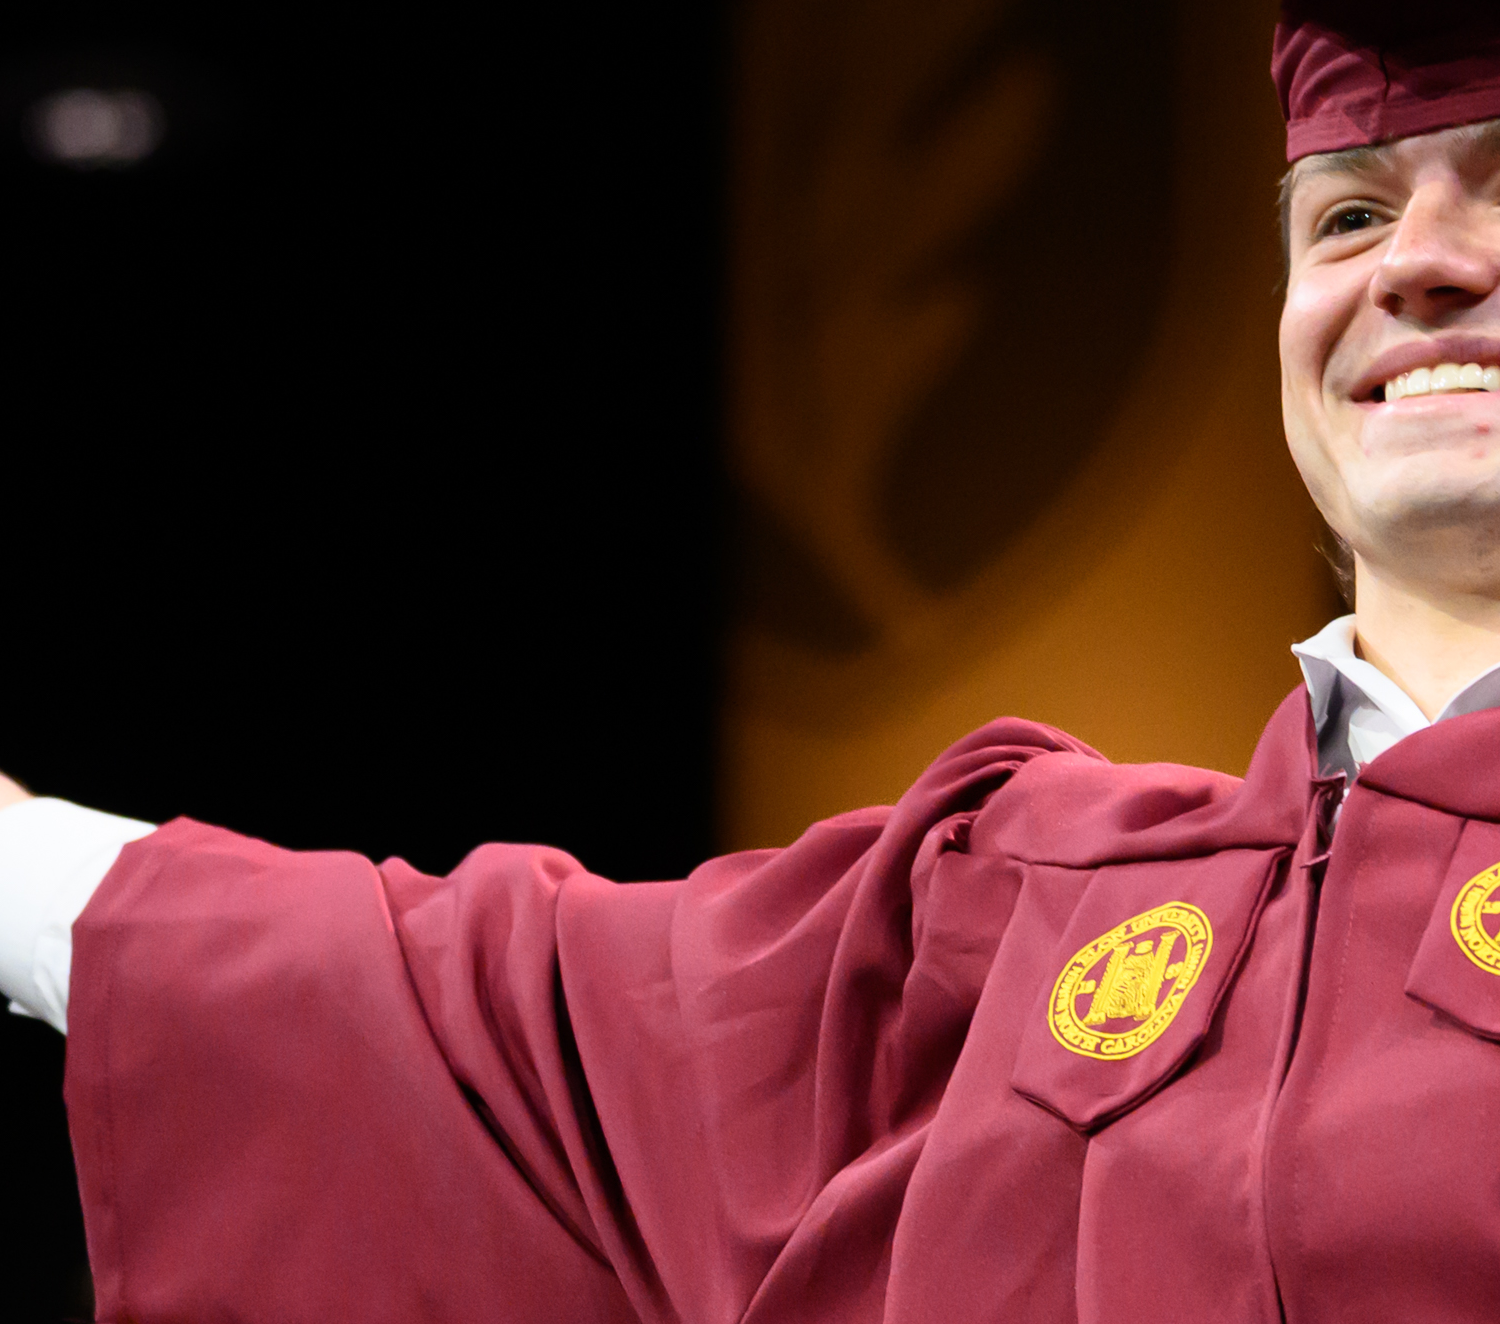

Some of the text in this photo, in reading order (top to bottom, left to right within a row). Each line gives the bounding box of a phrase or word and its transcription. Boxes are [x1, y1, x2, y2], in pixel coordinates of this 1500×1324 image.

[1078, 926, 1128, 966] ELON
[1054, 992, 1185, 1055] NORTH CAROLINA
